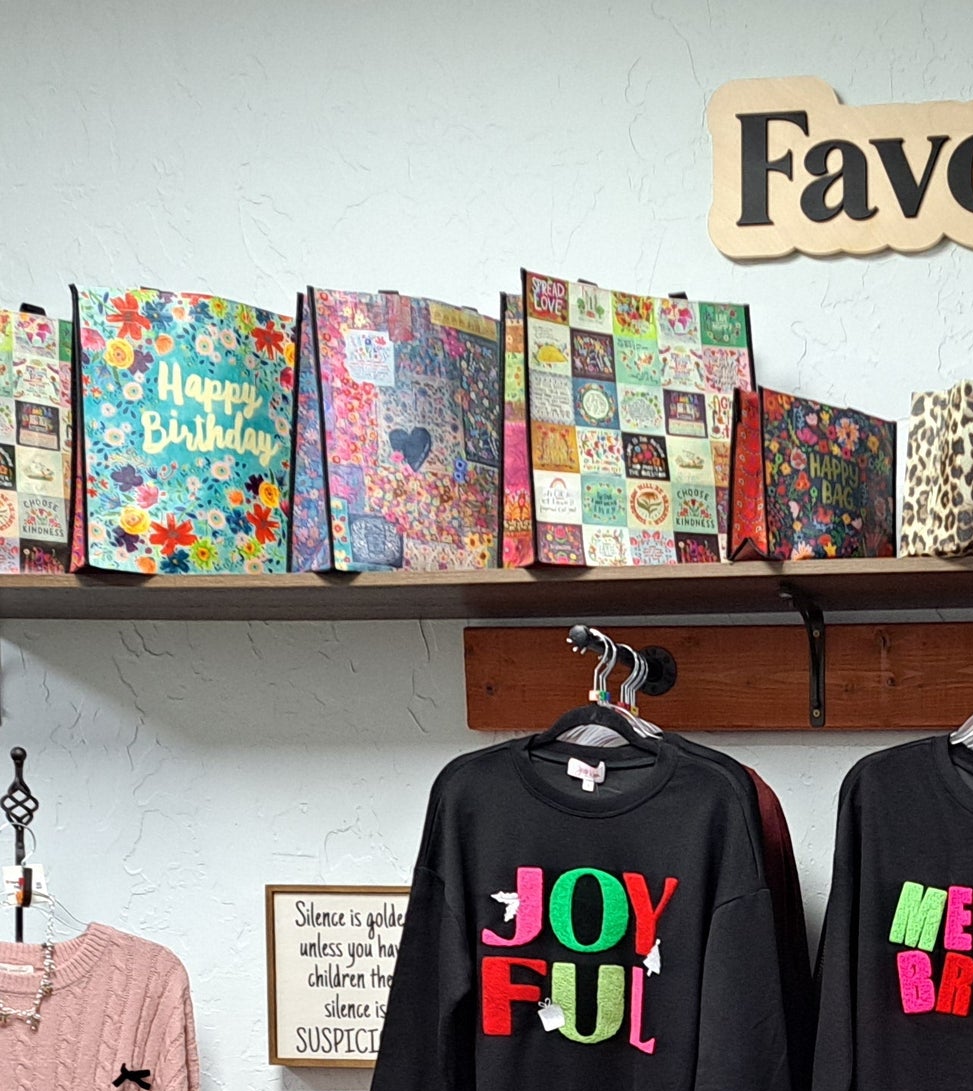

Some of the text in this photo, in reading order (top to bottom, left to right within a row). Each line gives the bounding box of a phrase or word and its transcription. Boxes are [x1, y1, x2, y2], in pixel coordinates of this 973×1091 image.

[532, 277, 565, 296] SPREAD
[534, 295, 563, 315] LOVE
[157, 359, 263, 419] Happy
[141, 409, 283, 467] Birthday
[809, 452, 859, 489] HAPPY
[23, 499, 59, 512] CHOOSE
[676, 488, 710, 501] CHOOSE
[821, 479, 855, 511] BAG
[22, 525, 64, 538] KINDNESS
[675, 517, 715, 530] KINDNESS
[295, 900, 346, 928] Silence
[350, 909, 362, 927] is
[481, 867, 679, 956] JOY
[300, 932, 343, 958] unless
[347, 943, 373, 968] you
[308, 964, 366, 989] children
[324, 993, 387, 1019] silence is
[481, 956, 656, 1054] FUL
[296, 1026, 383, 1054] SUSPICI
